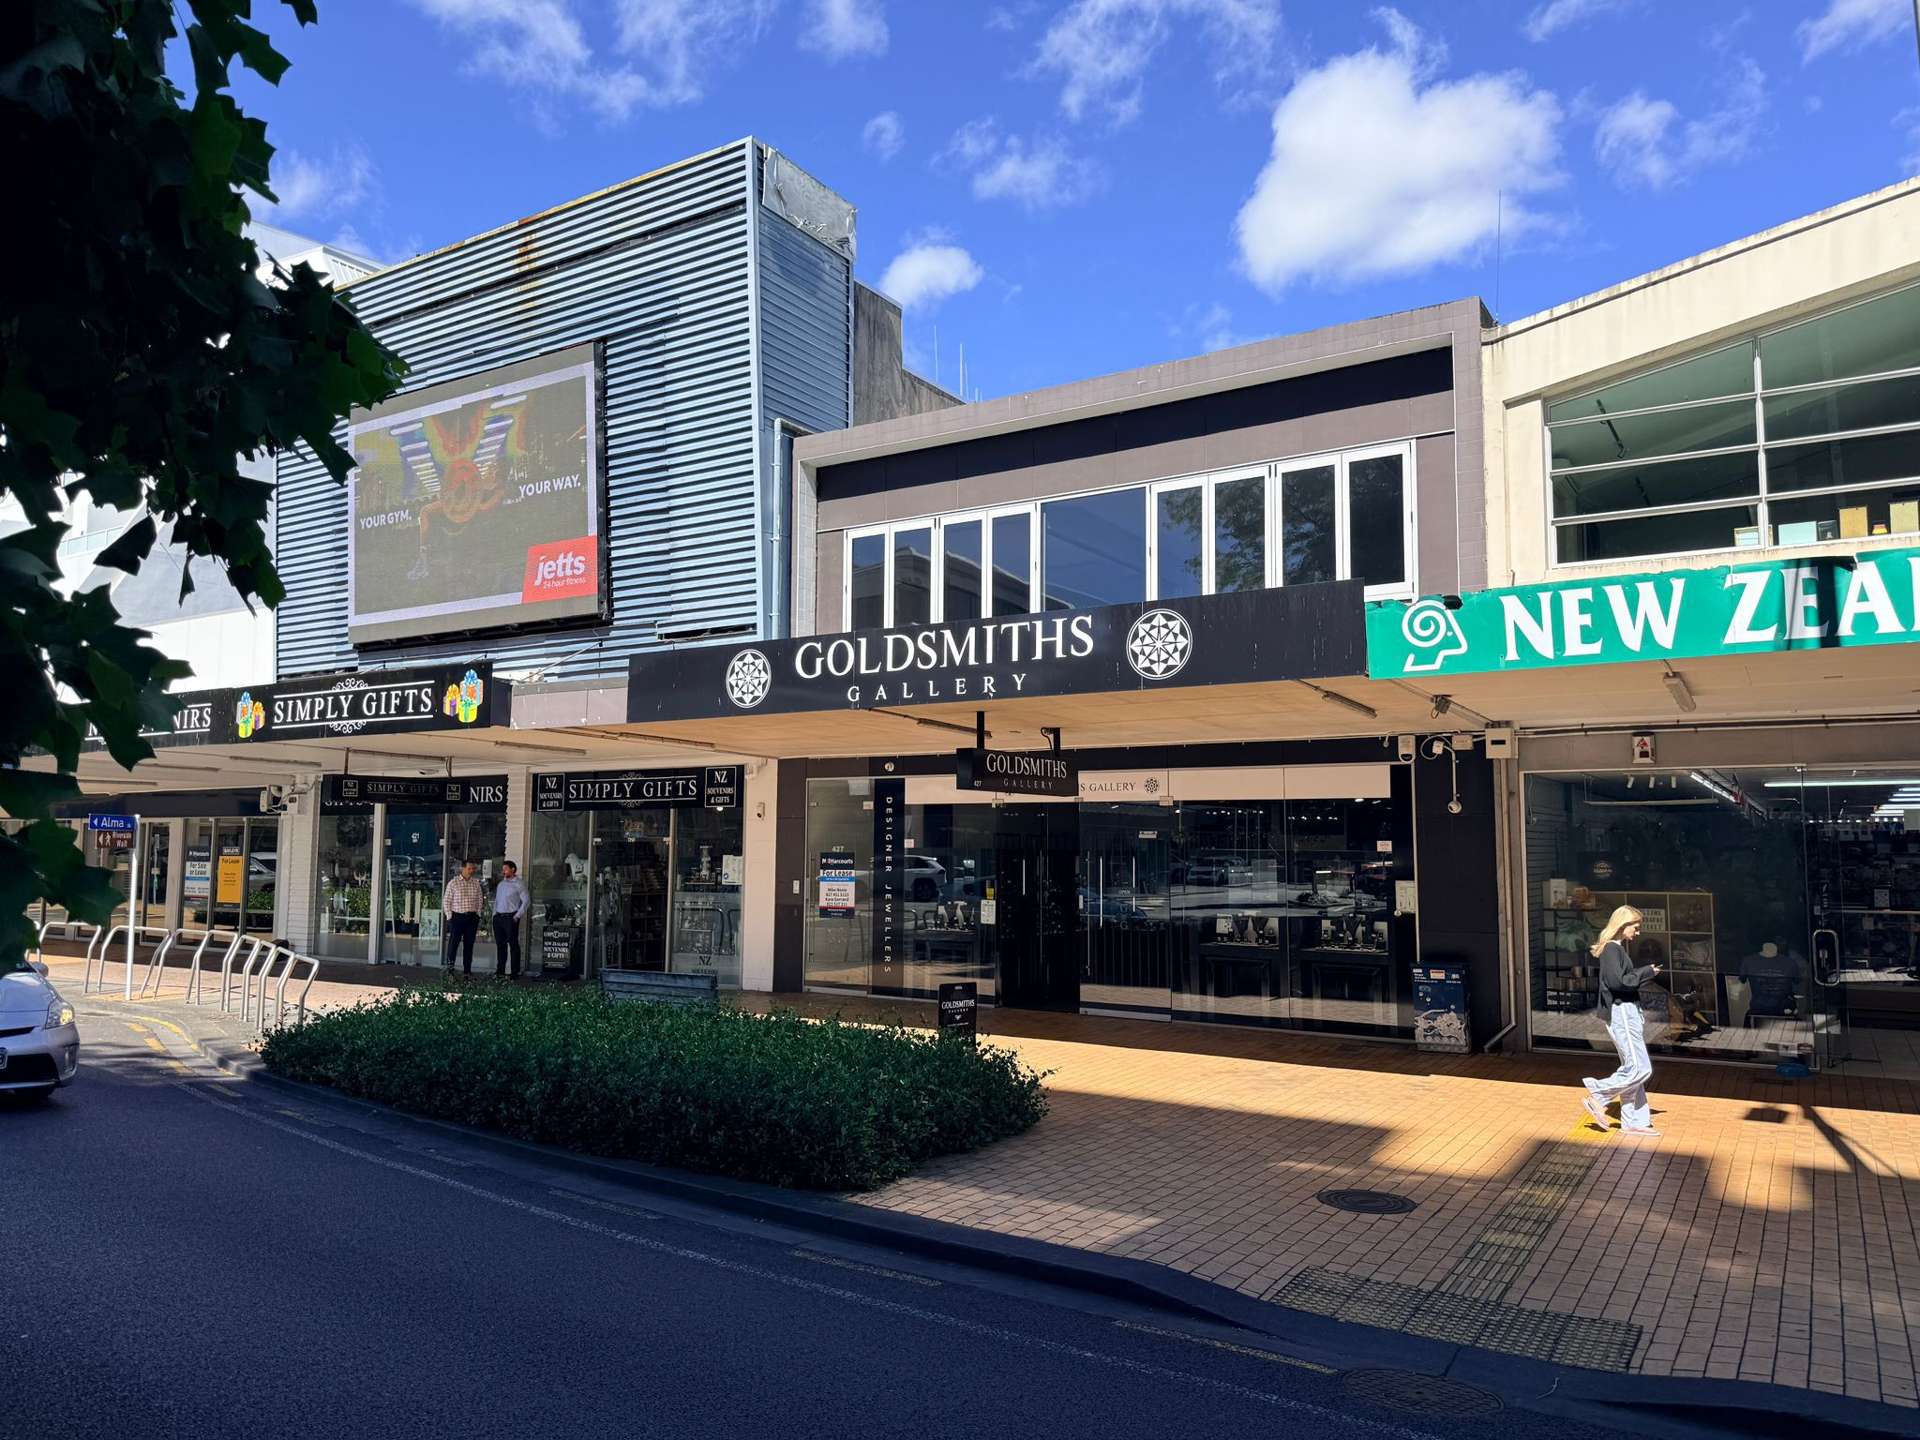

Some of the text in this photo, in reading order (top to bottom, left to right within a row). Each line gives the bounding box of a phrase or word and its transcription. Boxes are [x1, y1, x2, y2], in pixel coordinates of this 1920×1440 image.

[519, 474, 581, 498] YOUR WAY.
[360, 509, 412, 529] YOUR GYM.
[534, 551, 586, 586] jetts
[1498, 577, 1686, 661] NEW
[794, 614, 1094, 679] GOLDSMITHS
[847, 673, 1027, 702] GALLERY
[273, 687, 433, 724] SIMPLY GIFTS
[986, 752, 1068, 779] GOLDSMITHS
[546, 777, 557, 789] NZ
[714, 770, 728, 784] NZ
[1003, 778, 1054, 791] GALLERY
[1089, 781, 1136, 793] GALLERY
[366, 783, 406, 793] SIMPLY
[568, 779, 697, 799] SIMPLY GIFTS
[706, 787, 734, 795] SOUVENIRS
[101, 816, 125, 828] Alma
[822, 869, 853, 877] For Lease
[884, 796, 893, 973] DESIGNER JEWELLERS
[941, 999, 975, 1010] GOLDSMITHS
